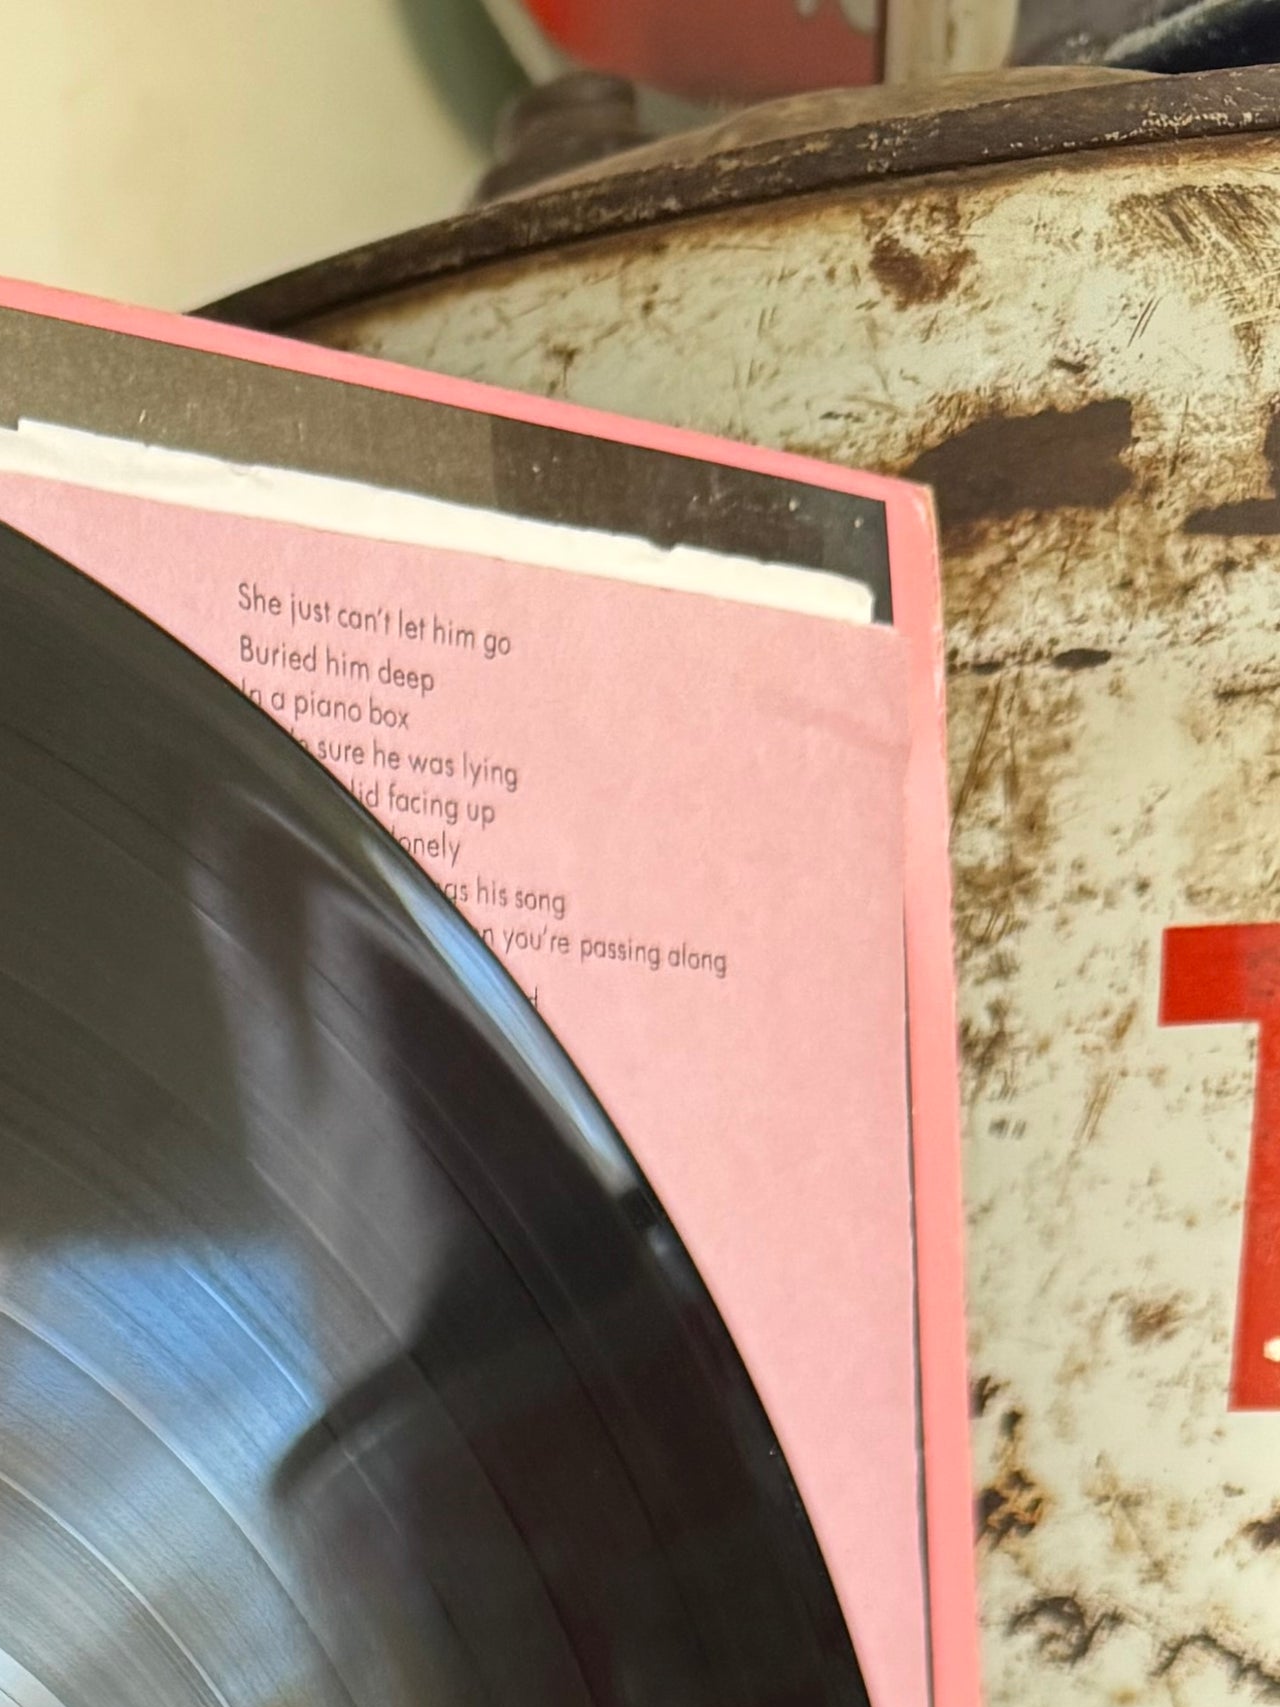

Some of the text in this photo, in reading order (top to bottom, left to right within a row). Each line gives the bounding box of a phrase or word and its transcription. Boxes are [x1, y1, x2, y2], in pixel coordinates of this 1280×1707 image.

[238, 583, 512, 659] She just can't let him go
[240, 636, 435, 696] Buried him deep
[270, 689, 410, 731] a piano box
[318, 739, 518, 792] sure he was lying
[390, 782, 458, 825] facing
[466, 804, 496, 828] up
[476, 875, 566, 920] his song
[504, 925, 728, 980] you're passing along
